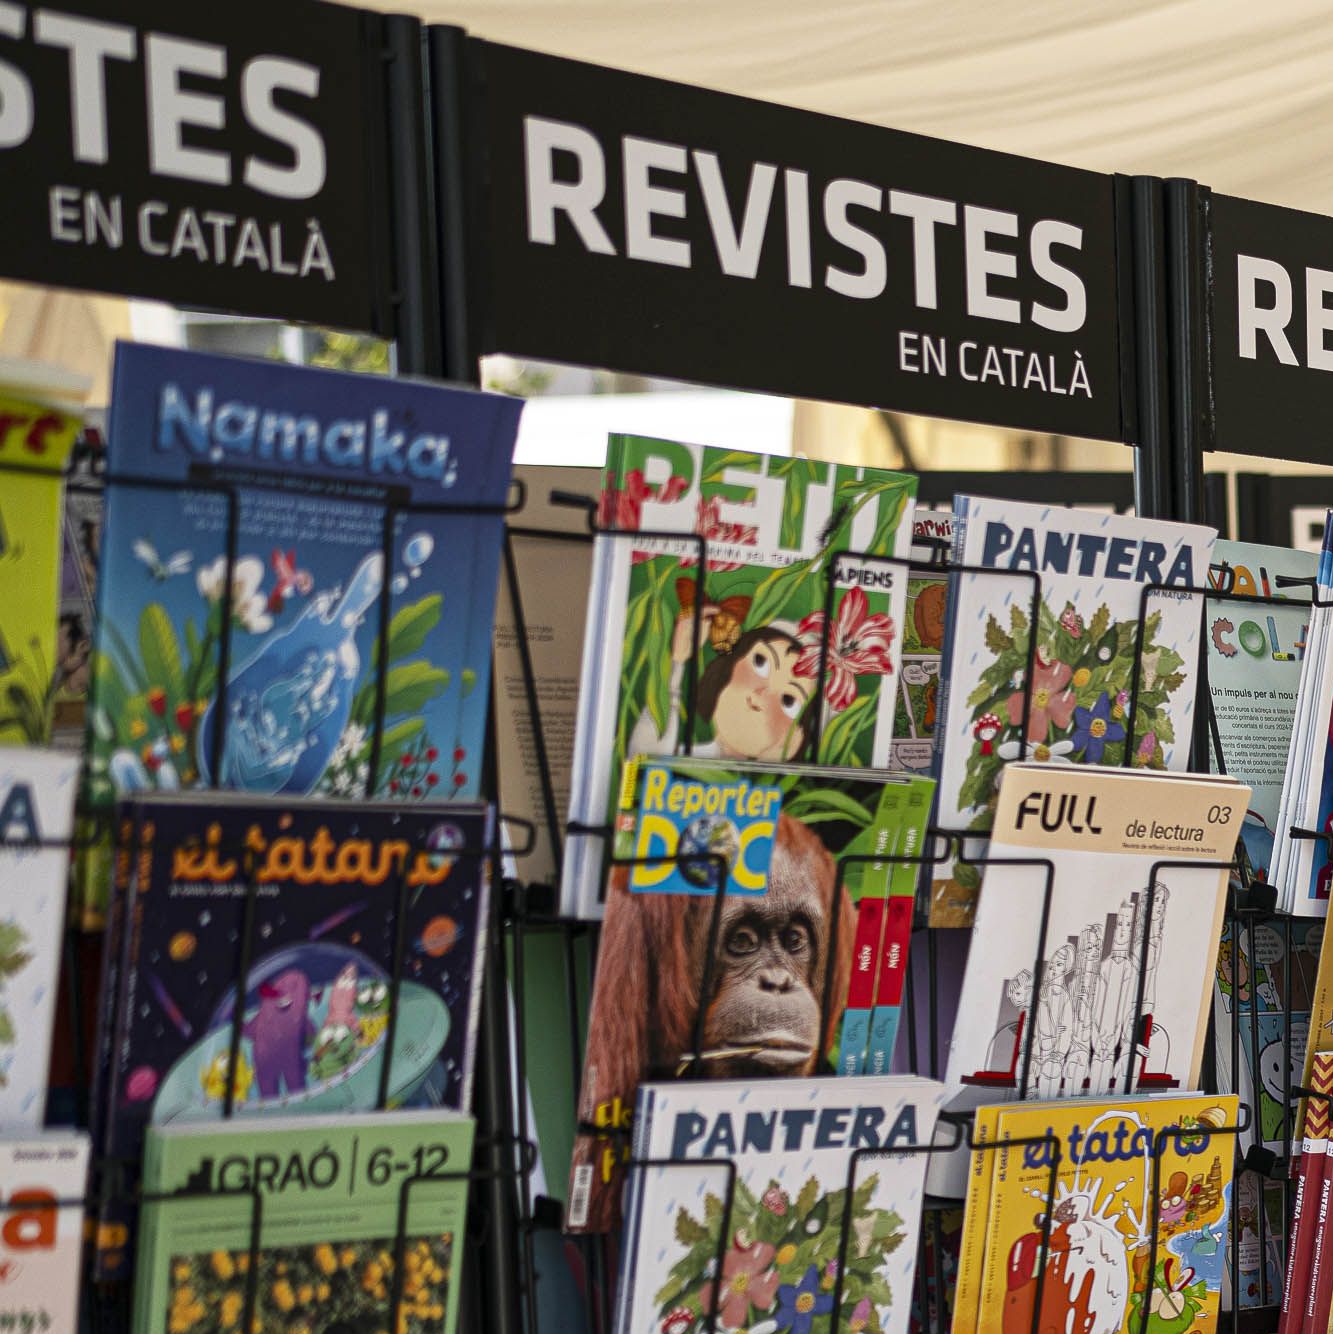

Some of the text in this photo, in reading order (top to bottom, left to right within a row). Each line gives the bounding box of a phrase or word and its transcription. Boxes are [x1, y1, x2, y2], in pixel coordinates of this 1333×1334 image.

[50, 186, 336, 282] EN CATALÀ
[523, 114, 1087, 333] REVISTES
[899, 331, 1093, 398] EN CATALÀ
[157, 384, 452, 482] Namaka
[622, 434, 918, 560] PETIT
[982, 520, 1194, 588] PANTERA
[1211, 687, 1294, 700] Un impuls per al nou
[644, 767, 781, 818] Reporter
[1015, 792, 1204, 842] FULL de lectura
[1207, 805, 1233, 825] 03
[671, 1104, 918, 1161] PANTERA
[217, 1144, 450, 1193] GRAÓ 6-12
[1294, 1175, 1306, 1220] PANTERA
[1319, 1179, 1331, 1223] PANTERA
